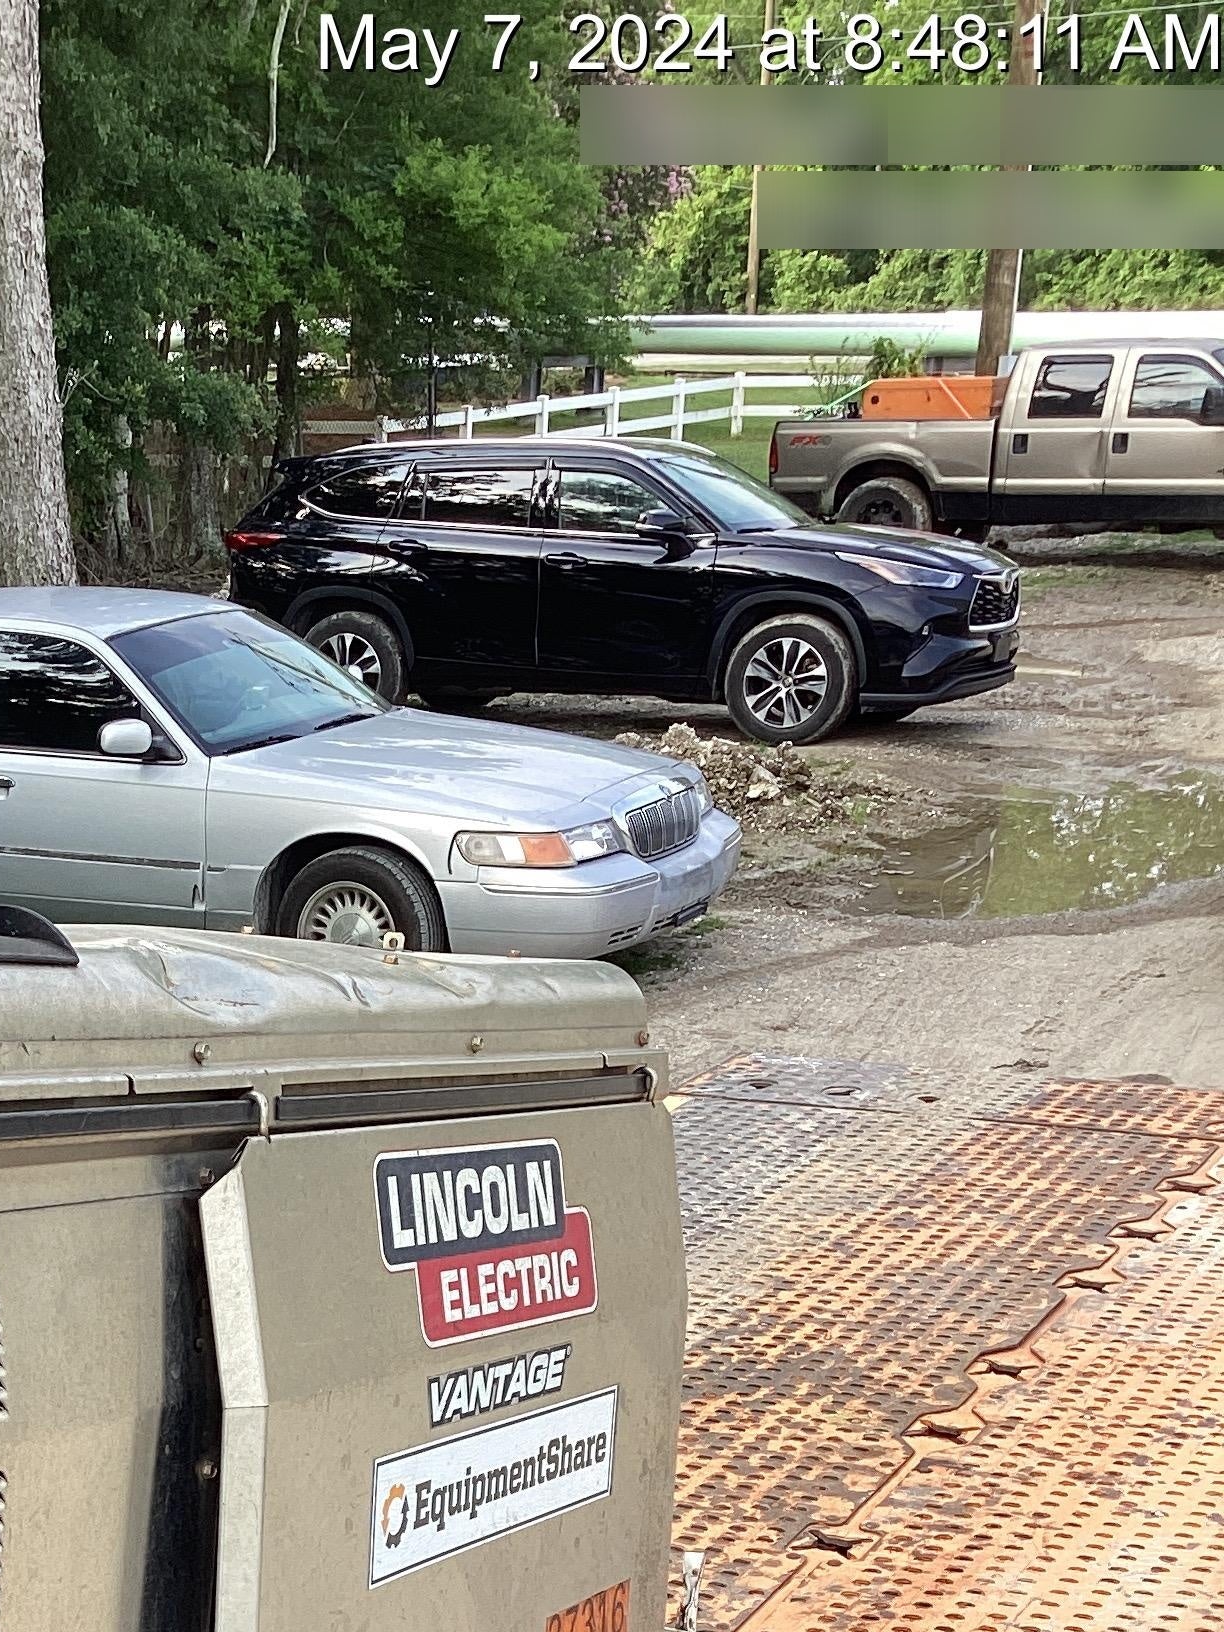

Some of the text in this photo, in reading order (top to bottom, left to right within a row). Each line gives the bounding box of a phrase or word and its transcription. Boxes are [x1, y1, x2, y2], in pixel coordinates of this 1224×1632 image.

[386, 1159, 557, 1250] LINCOLN
[440, 1247, 580, 1324] ELECTRIC
[428, 1348, 567, 1426] VANTAGE
[413, 1429, 607, 1533] EquipmentShare
